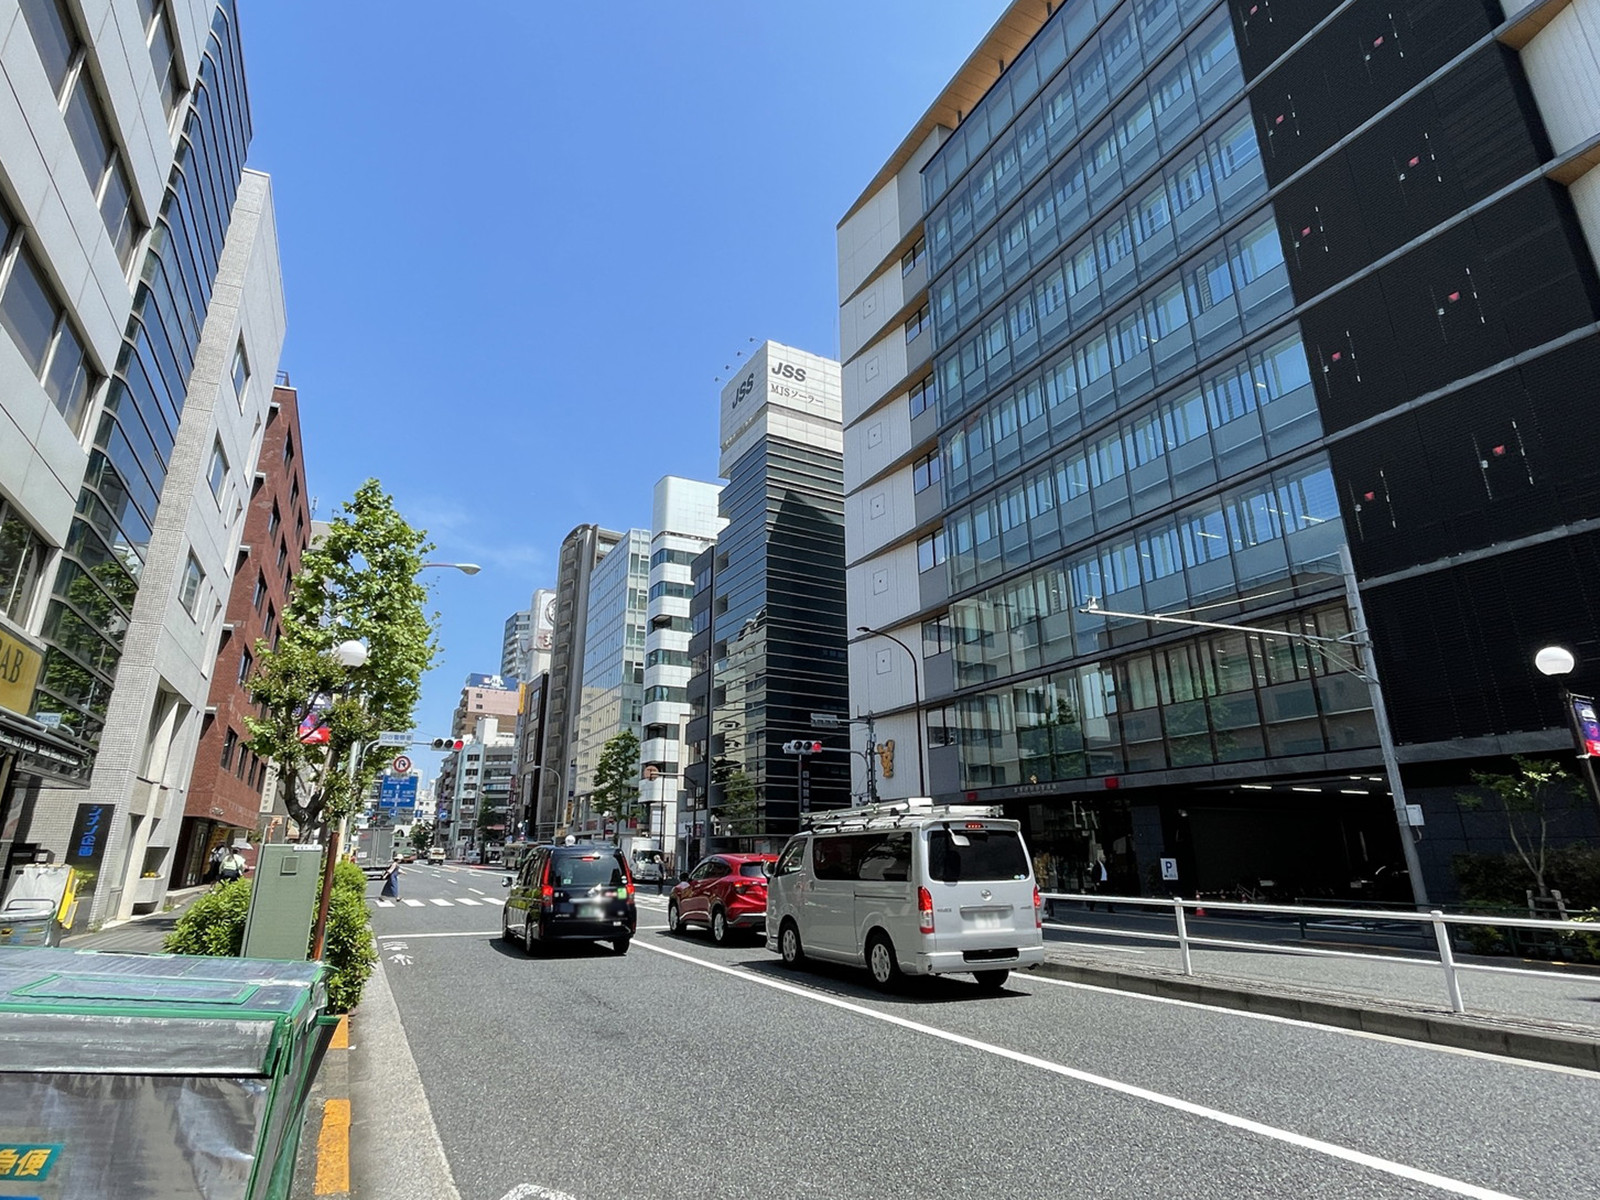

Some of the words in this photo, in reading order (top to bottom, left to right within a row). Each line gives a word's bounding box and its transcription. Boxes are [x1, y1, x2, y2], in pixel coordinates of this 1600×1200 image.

[771, 362, 807, 382] JSS
[732, 372, 754, 409] JSS
[0, 638, 24, 683] AB
[1165, 861, 1173, 873] P
